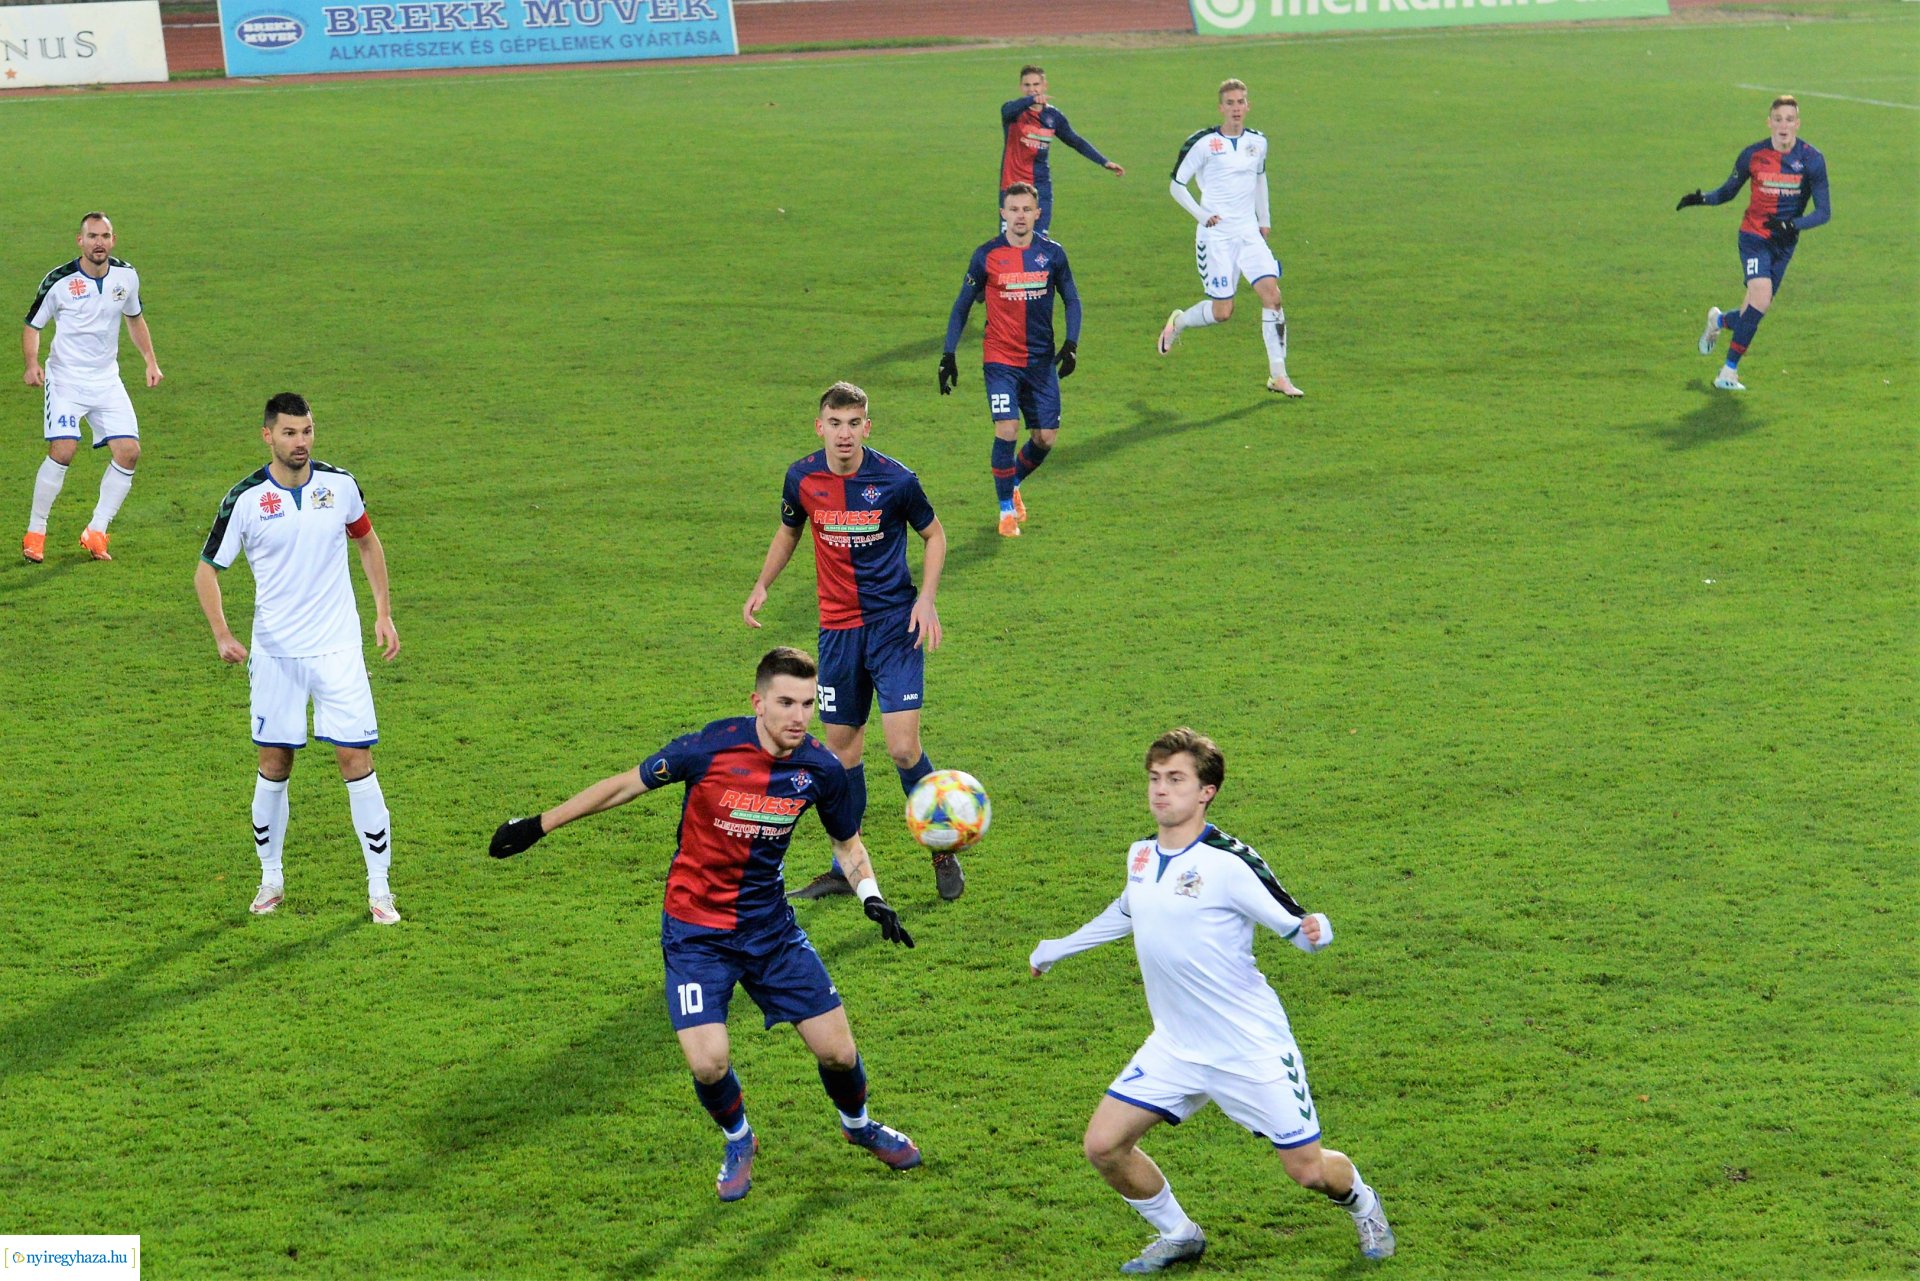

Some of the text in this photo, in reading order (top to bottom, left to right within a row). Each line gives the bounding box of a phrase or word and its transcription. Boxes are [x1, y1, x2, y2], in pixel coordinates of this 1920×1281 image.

[323, 1, 508, 36] BREKK
[329, 28, 722, 60] ALKATRÉSZEK ÉS GÉPELEMEK GYÁRTÁSA
[1746, 257, 1759, 275] 21
[991, 393, 1010, 413] 22
[813, 509, 883, 525] REVESZ
[817, 685, 836, 712] 32
[903, 692, 919, 701] JAKO
[256, 715, 266, 736] 7
[719, 789, 806, 816] REVESZ
[713, 818, 761, 835] LERTON
[677, 982, 703, 1016] 10
[1122, 1065, 1145, 1082] 7
